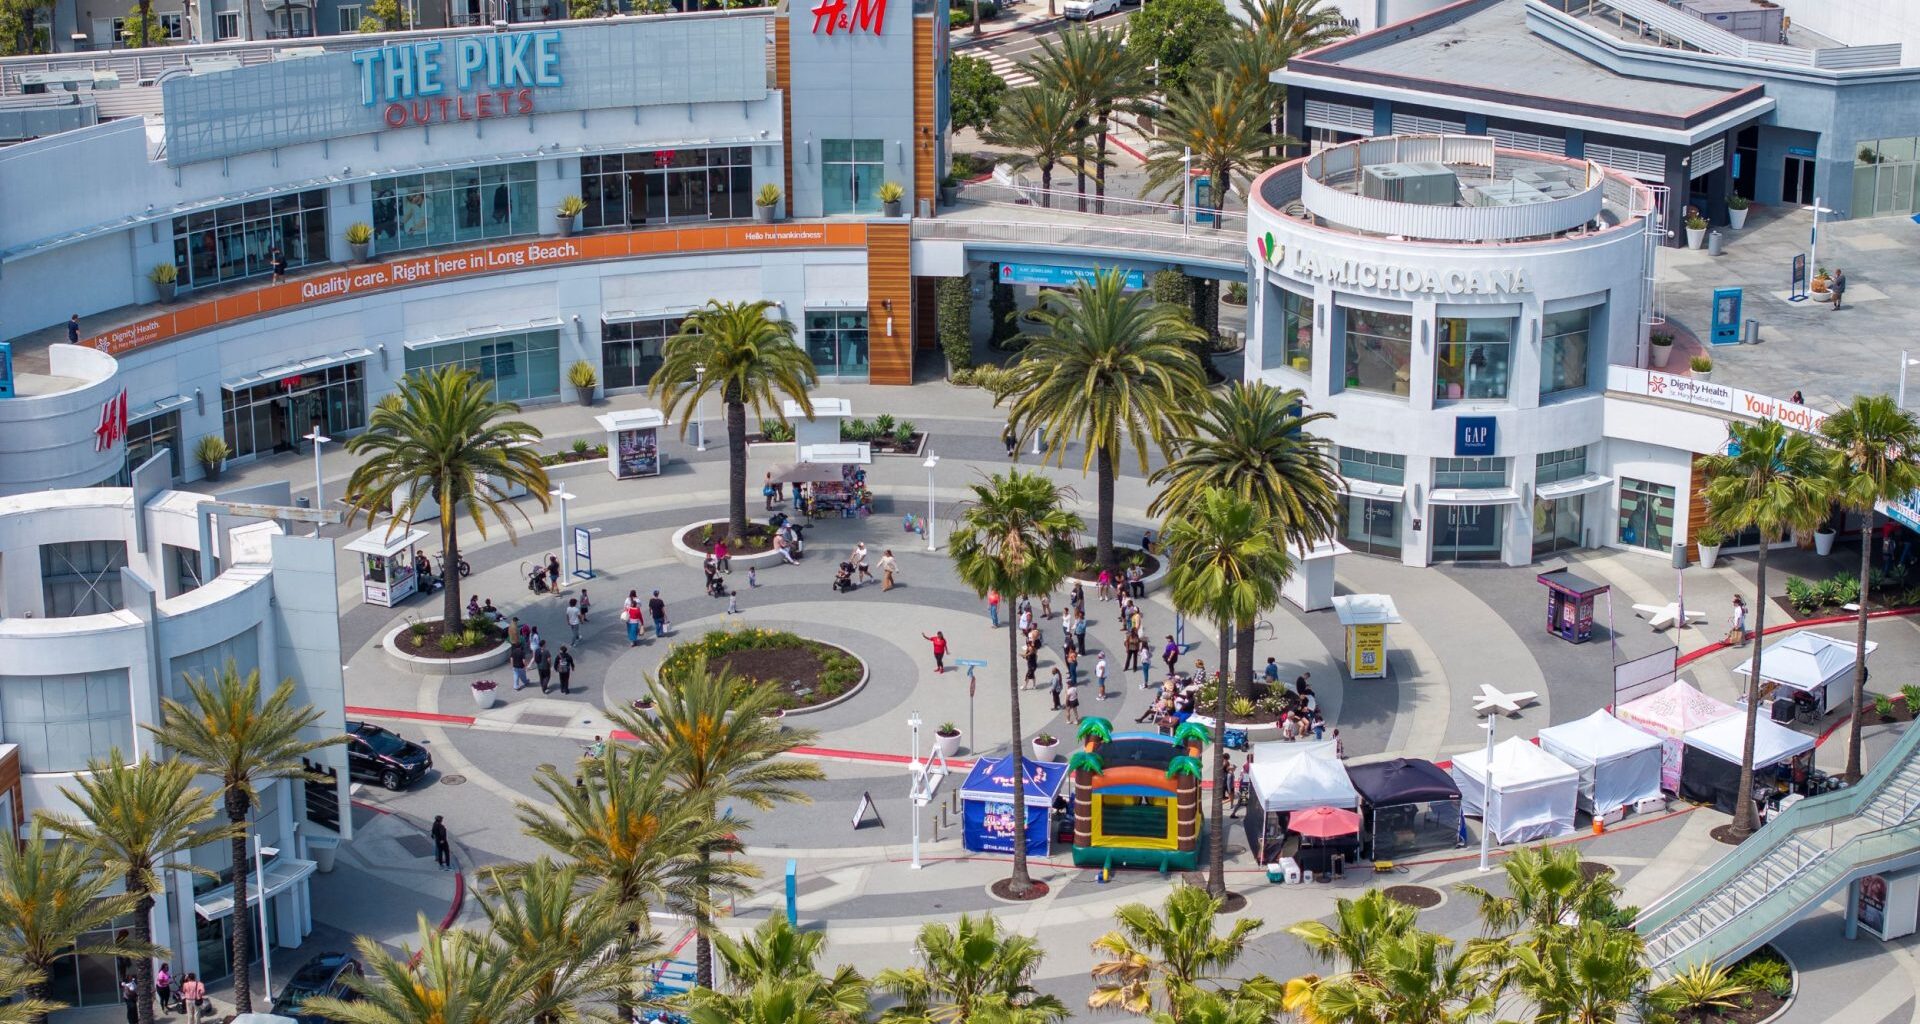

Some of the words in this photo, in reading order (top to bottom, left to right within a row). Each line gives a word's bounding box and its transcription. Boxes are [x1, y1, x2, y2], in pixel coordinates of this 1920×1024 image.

[811, 0, 887, 36] H&M
[352, 40, 443, 107] THE
[455, 29, 563, 91] PIKE
[384, 88, 534, 128] OUTLETS
[745, 232, 764, 240] Hello
[303, 277, 351, 297] Quality
[354, 271, 388, 287] care.
[393, 261, 431, 280] Right
[434, 259, 467, 274] here
[470, 253, 484, 268] in
[488, 250, 524, 265] Long
[528, 242, 579, 261] Beach.
[1294, 249, 1323, 278] LA
[1326, 254, 1534, 295] MICHOACANA
[112, 329, 136, 343] Dignity
[1670, 379, 1701, 394] Dignity
[1701, 385, 1728, 397] Health
[94, 385, 128, 452] H&M
[1745, 394, 1775, 416] Your
[1778, 403, 1812, 430] body
[1465, 426, 1487, 443] GAP
[1448, 504, 1481, 525] GAP
